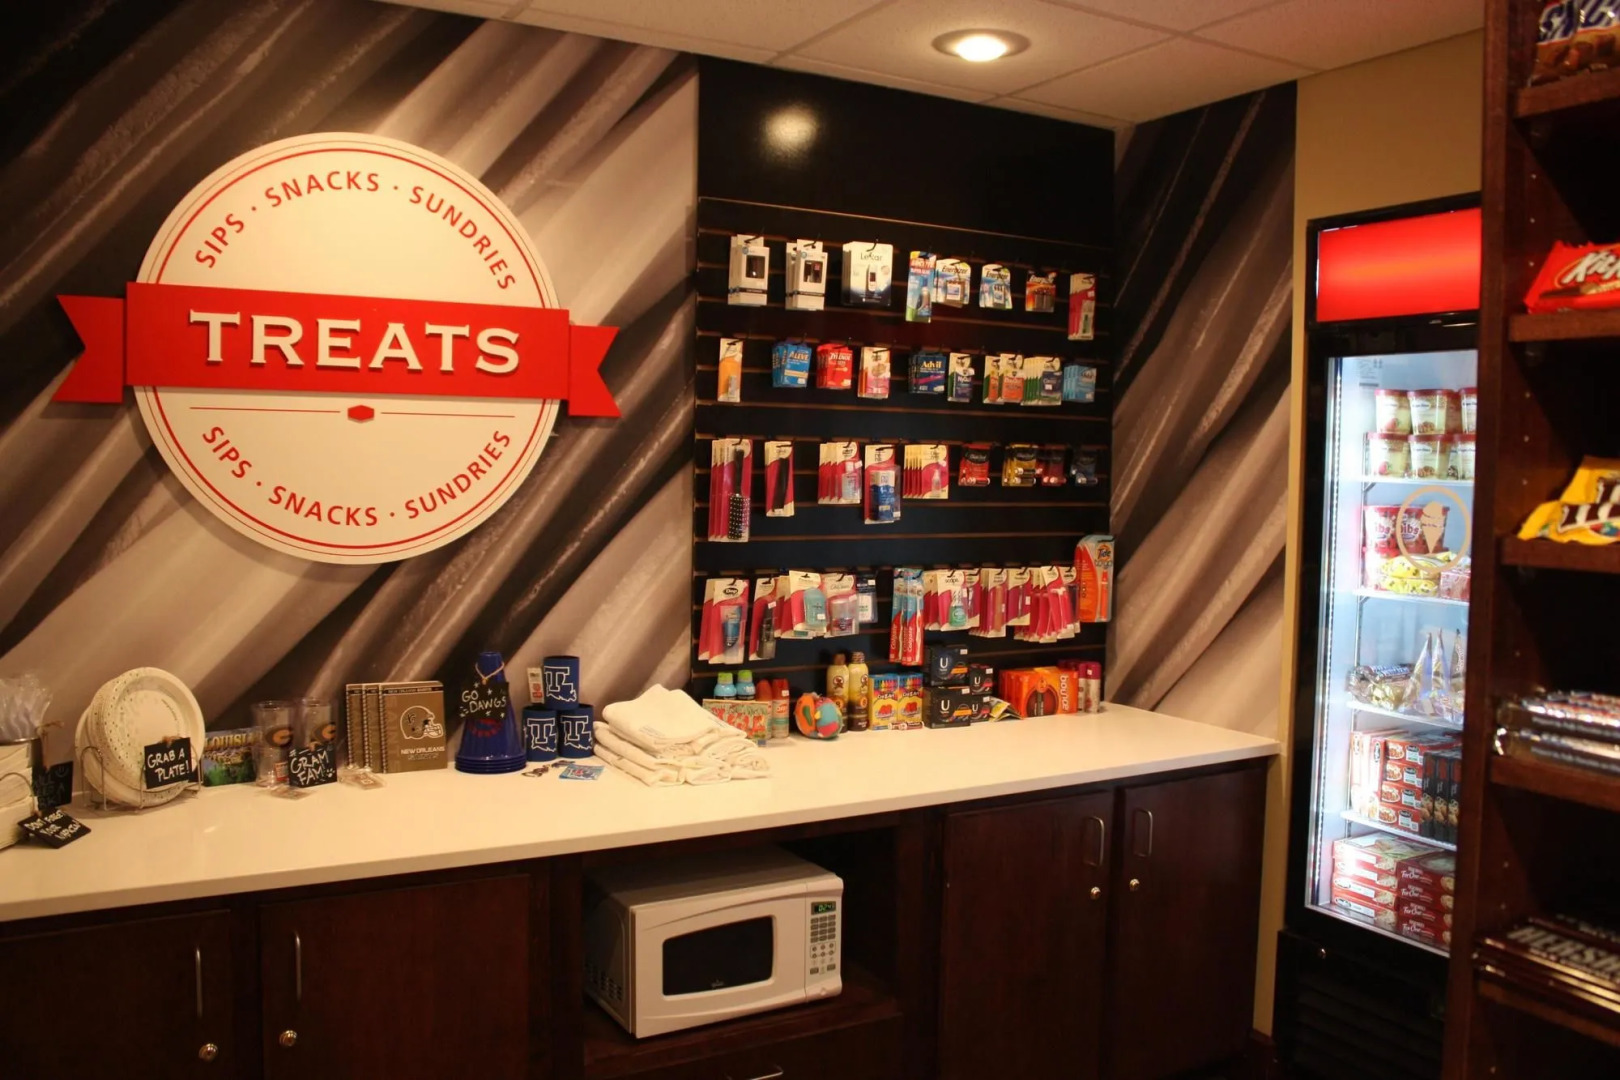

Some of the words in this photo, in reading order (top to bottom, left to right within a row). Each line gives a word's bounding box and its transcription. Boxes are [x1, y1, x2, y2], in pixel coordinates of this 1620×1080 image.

[195, 212, 246, 269] SIPS
[264, 169, 382, 209] SNACKS
[408, 186, 516, 291] SUNDRIES
[189, 309, 521, 374] TREATS
[788, 350, 810, 361] ALEVE
[921, 359, 943, 370] Advil
[201, 426, 252, 479] SIPS
[268, 485, 379, 528] SNACKS
[404, 430, 512, 519] SUNDRIES
[1097, 548, 1111, 560] Tide
[940, 657, 949, 669] U
[974, 676, 981, 688] U
[462, 690, 479, 703] GO
[1059, 675, 1071, 711] bounce
[469, 696, 507, 714] DAWGS
[941, 700, 950, 712] U
[972, 703, 979, 714] U
[416, 746, 445, 754] ORLEANS
[147, 750, 176, 769] GRAB
[177, 748, 186, 761] A
[290, 751, 330, 775] GRAM
[154, 759, 189, 782] PLATE!
[299, 767, 325, 786] FAM
